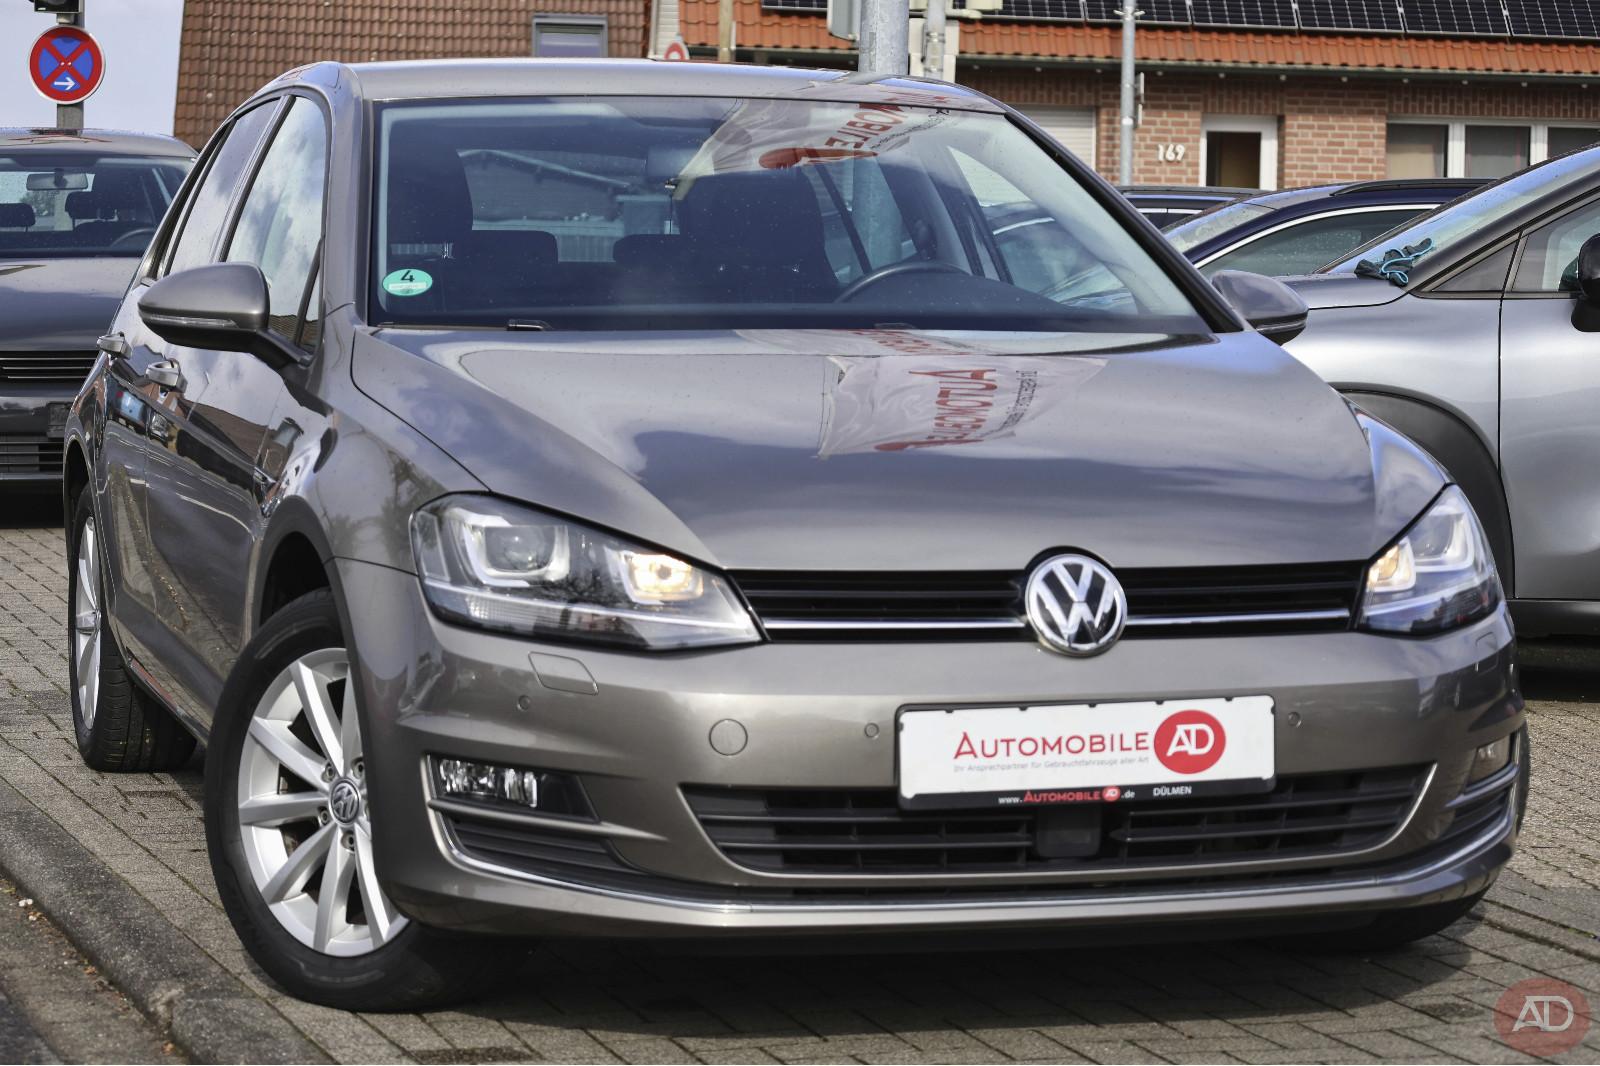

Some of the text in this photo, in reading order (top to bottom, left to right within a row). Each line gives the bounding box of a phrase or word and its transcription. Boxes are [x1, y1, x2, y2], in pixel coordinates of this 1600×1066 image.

[1158, 144, 1185, 161] 169
[401, 270, 415, 282] 4
[953, 723, 1216, 759] AUTOMOBILE AD
[1152, 785, 1193, 797] DÜLMEN
